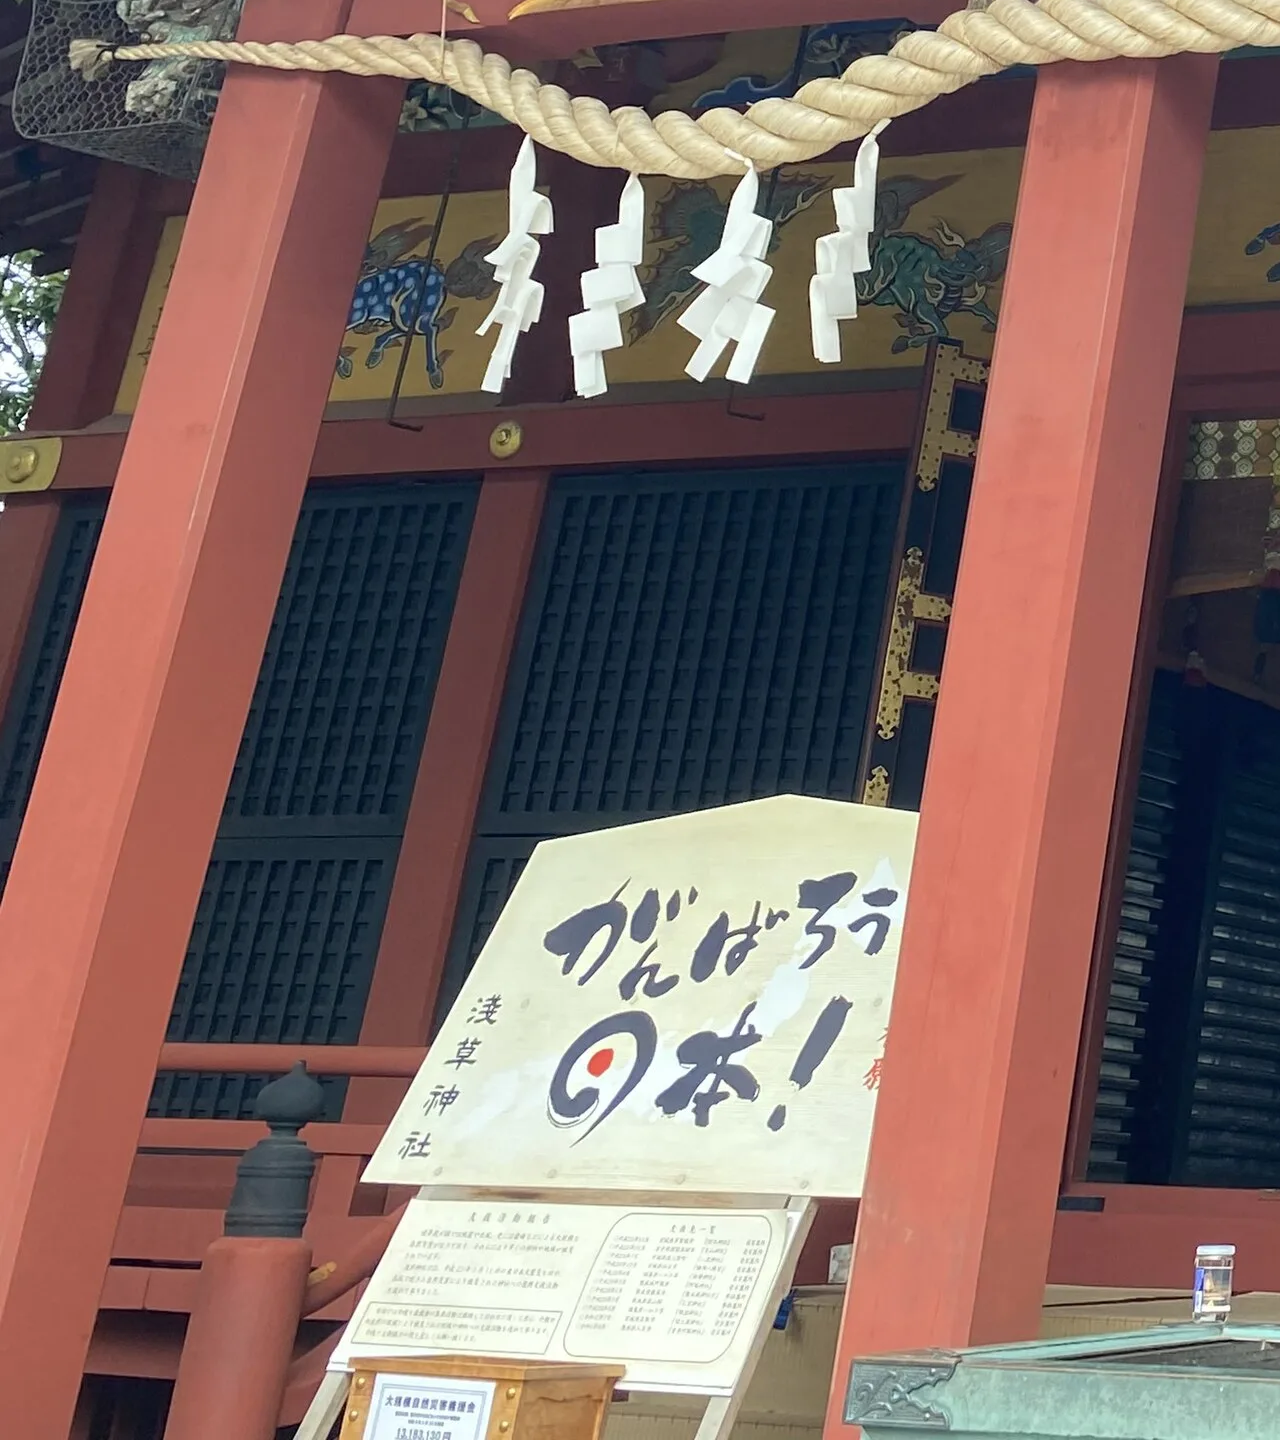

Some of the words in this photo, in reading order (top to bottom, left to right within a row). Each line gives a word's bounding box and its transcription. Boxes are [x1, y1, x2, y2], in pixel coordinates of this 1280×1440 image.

[543, 876, 899, 1001] がんばろう
